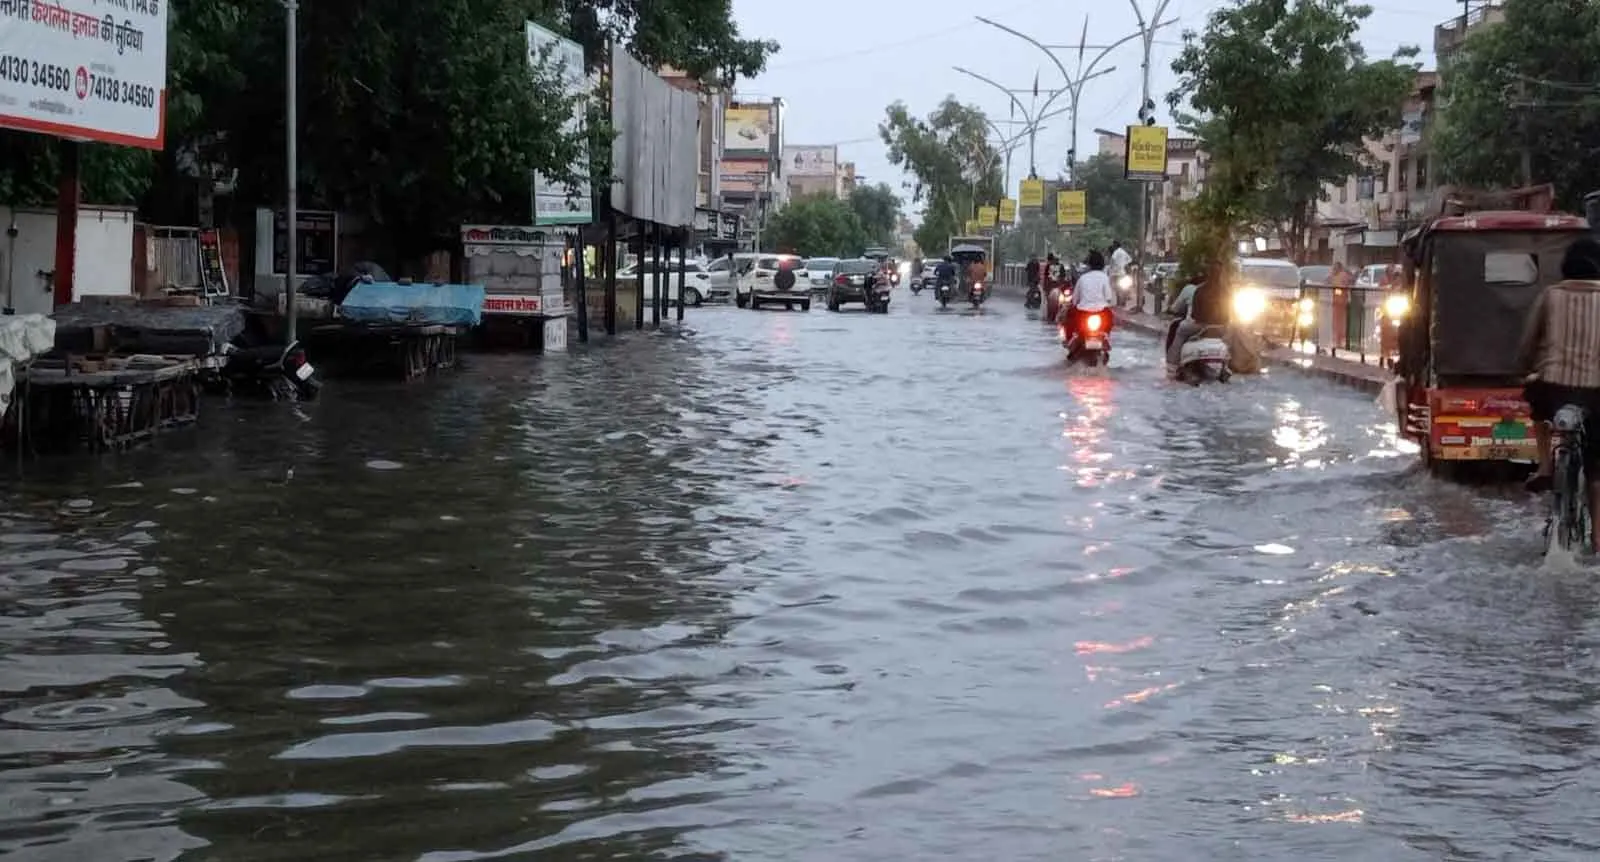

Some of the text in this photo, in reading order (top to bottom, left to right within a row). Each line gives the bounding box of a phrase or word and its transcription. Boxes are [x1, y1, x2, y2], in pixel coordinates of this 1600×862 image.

[101, 14, 114, 43] की
[115, 20, 144, 55] सुविधा
[32, 62, 70, 91] 34560
[89, 74, 119, 102] 74138
[122, 82, 154, 108] 34560
